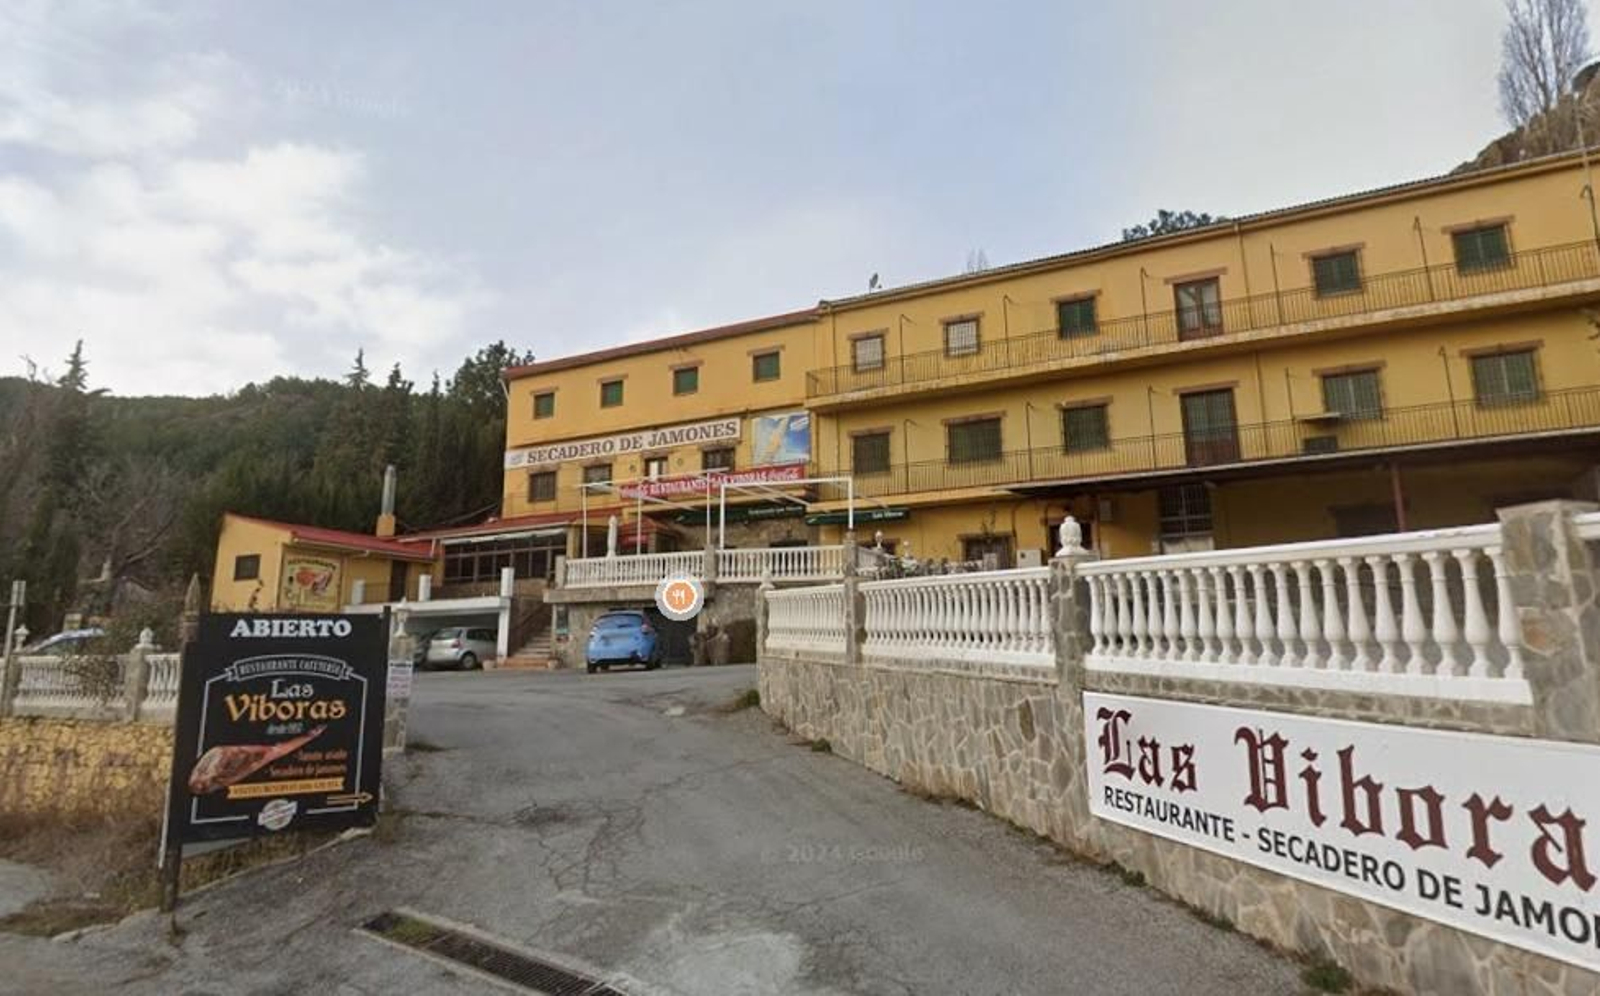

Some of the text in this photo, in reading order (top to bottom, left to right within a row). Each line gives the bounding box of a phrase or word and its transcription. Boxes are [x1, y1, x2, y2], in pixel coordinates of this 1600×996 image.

[527, 439, 614, 464] SECADERO
[619, 435, 643, 451] DE
[649, 421, 737, 448] JAMONES
[230, 618, 352, 637] ABIERTO
[270, 679, 314, 698] Las
[1096, 707, 1198, 794] Las
[1104, 785, 1235, 843] RESTAURANTE
[1258, 828, 1406, 892] SECADERO
[1416, 868, 1464, 909] DE
